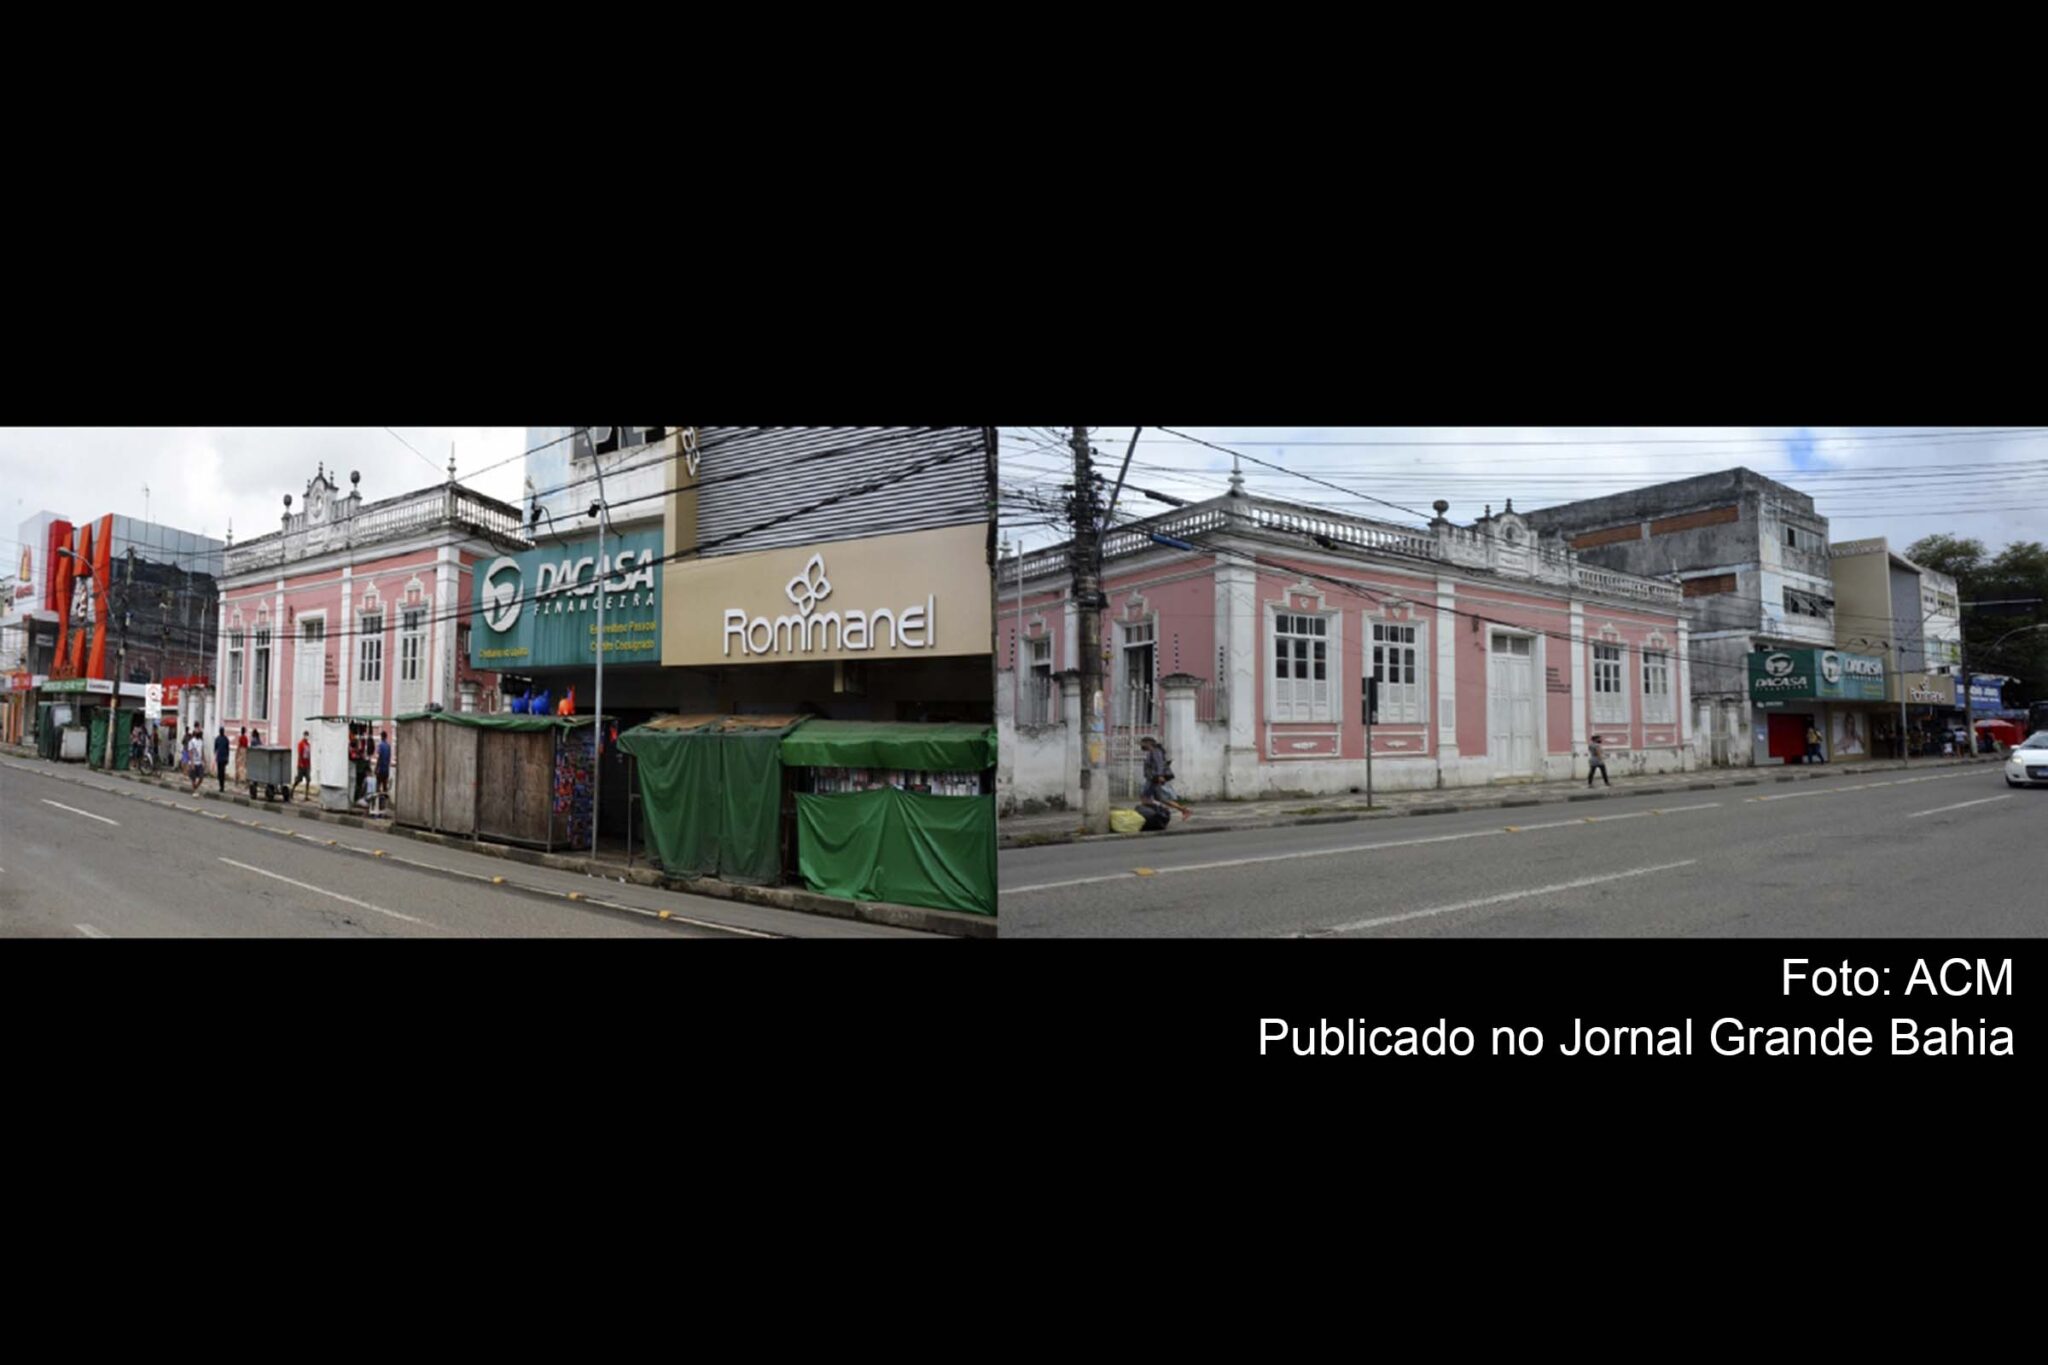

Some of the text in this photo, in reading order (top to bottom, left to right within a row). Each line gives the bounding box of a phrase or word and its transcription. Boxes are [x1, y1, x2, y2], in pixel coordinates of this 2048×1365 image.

[535, 549, 654, 598] DACASA
[533, 593, 655, 616] FINANCEIRA
[724, 593, 935, 656] Rommanel
[1755, 676, 1808, 688] DACASA
